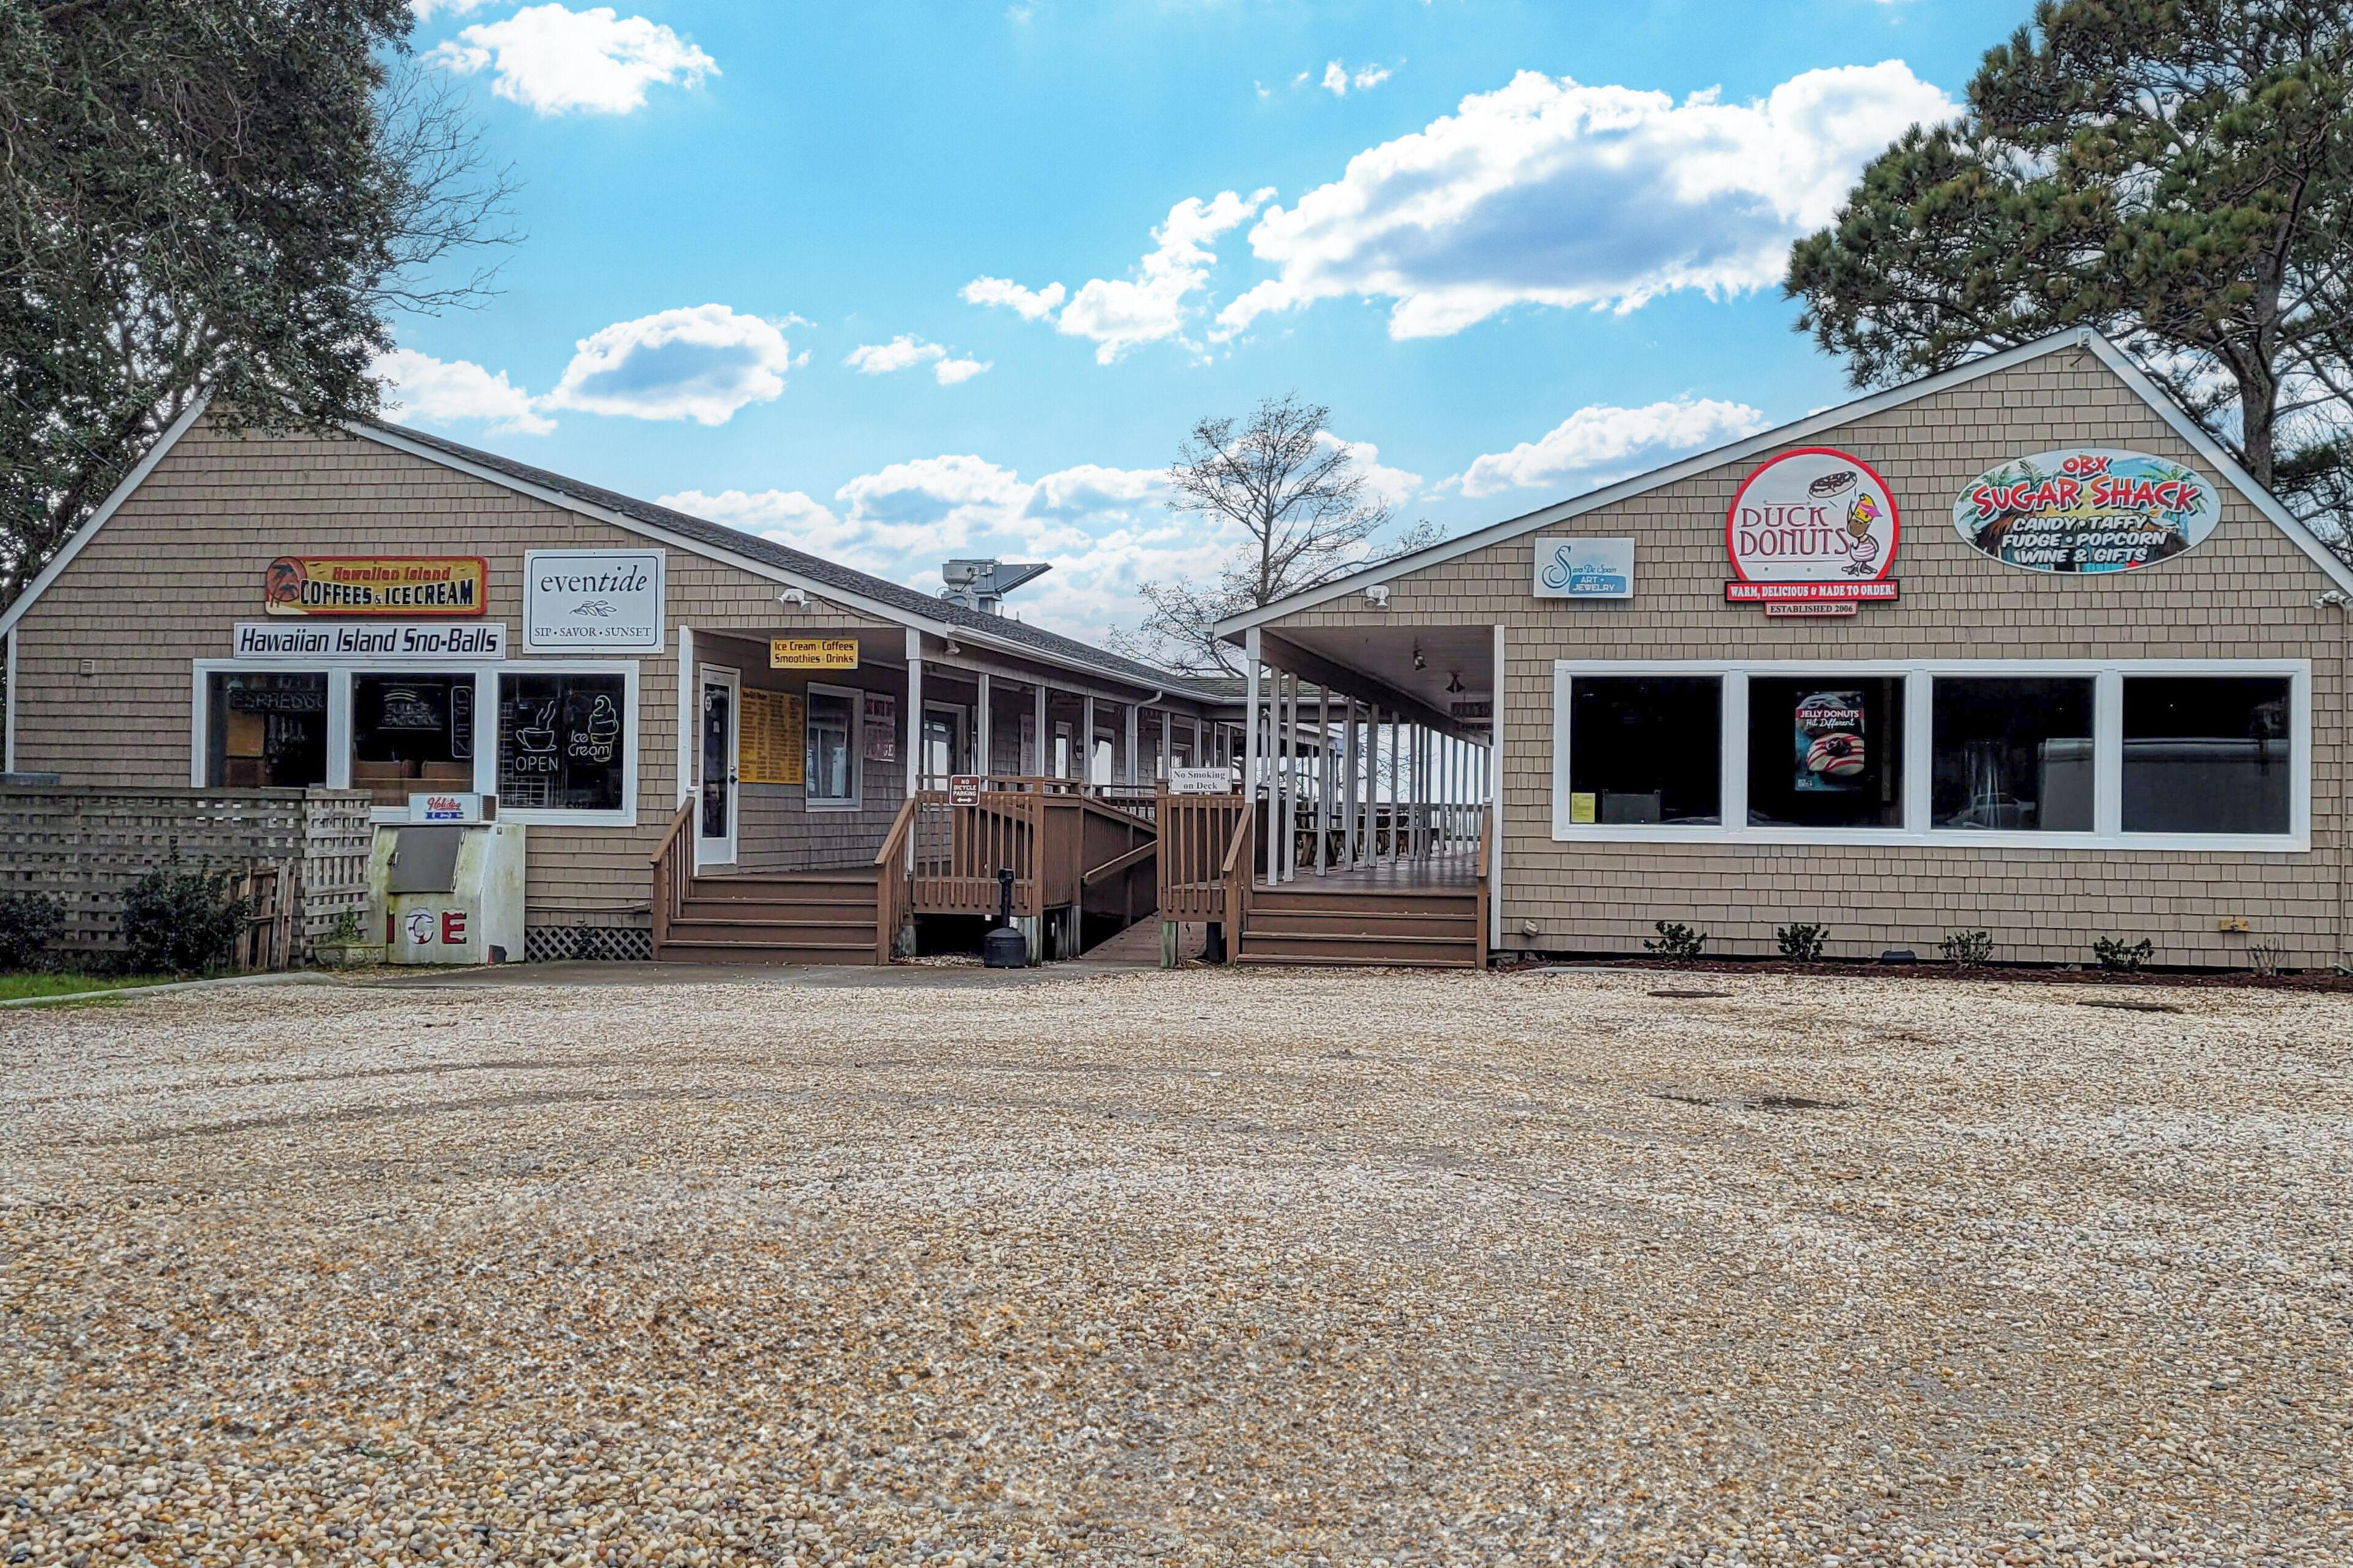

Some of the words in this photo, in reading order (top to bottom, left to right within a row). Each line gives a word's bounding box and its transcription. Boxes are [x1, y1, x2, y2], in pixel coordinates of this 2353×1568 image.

[2062, 455, 2110, 477] OBX
[1972, 478, 2081, 519] SUGAR
[2090, 474, 2200, 515] SHACK
[1740, 506, 1829, 528] DUCK
[2012, 517, 2079, 531] CANDY
[2089, 515, 2147, 530] TAFFY
[1739, 527, 1851, 556] DONUTS
[2001, 533, 2060, 548] FUDGE
[2075, 531, 2167, 546] POPCORN
[2020, 549, 2067, 563] WINE
[2074, 549, 2087, 562] &
[2093, 548, 2148, 563] GIFTS
[333, 566, 400, 581] Hawaiian
[404, 566, 451, 580] Island
[1597, 564, 1616, 575] Spain
[540, 564, 648, 593] eventide
[300, 579, 373, 605] COFFEES
[374, 594, 382, 604] &
[385, 585, 411, 605] ICE
[414, 579, 474, 605] CREAM
[1730, 586, 1761, 599] WARM,
[1762, 586, 1809, 597] DELICIOUS
[1819, 585, 1846, 596] MADE
[1847, 585, 1858, 596] TO
[1861, 585, 1895, 596] ORDER!
[534, 627, 551, 637] SIP
[559, 627, 597, 637] SAVOR
[604, 627, 651, 637] SUNSET
[240, 628, 330, 652] Hawaiian
[335, 628, 398, 652] Island
[402, 628, 498, 653] Sno-Balls
[775, 642, 787, 651] Ice
[789, 641, 817, 651] Cream
[822, 641, 854, 651] Coffees
[775, 653, 821, 663] Smoothies
[826, 653, 854, 663] Drinks
[1819, 718, 1855, 729] Different
[570, 729, 589, 743] Ice
[568, 744, 610, 757] Cream
[515, 756, 559, 771] OPEN
[1188, 771, 1226, 781] Smoking
[387, 907, 467, 944] ICE
